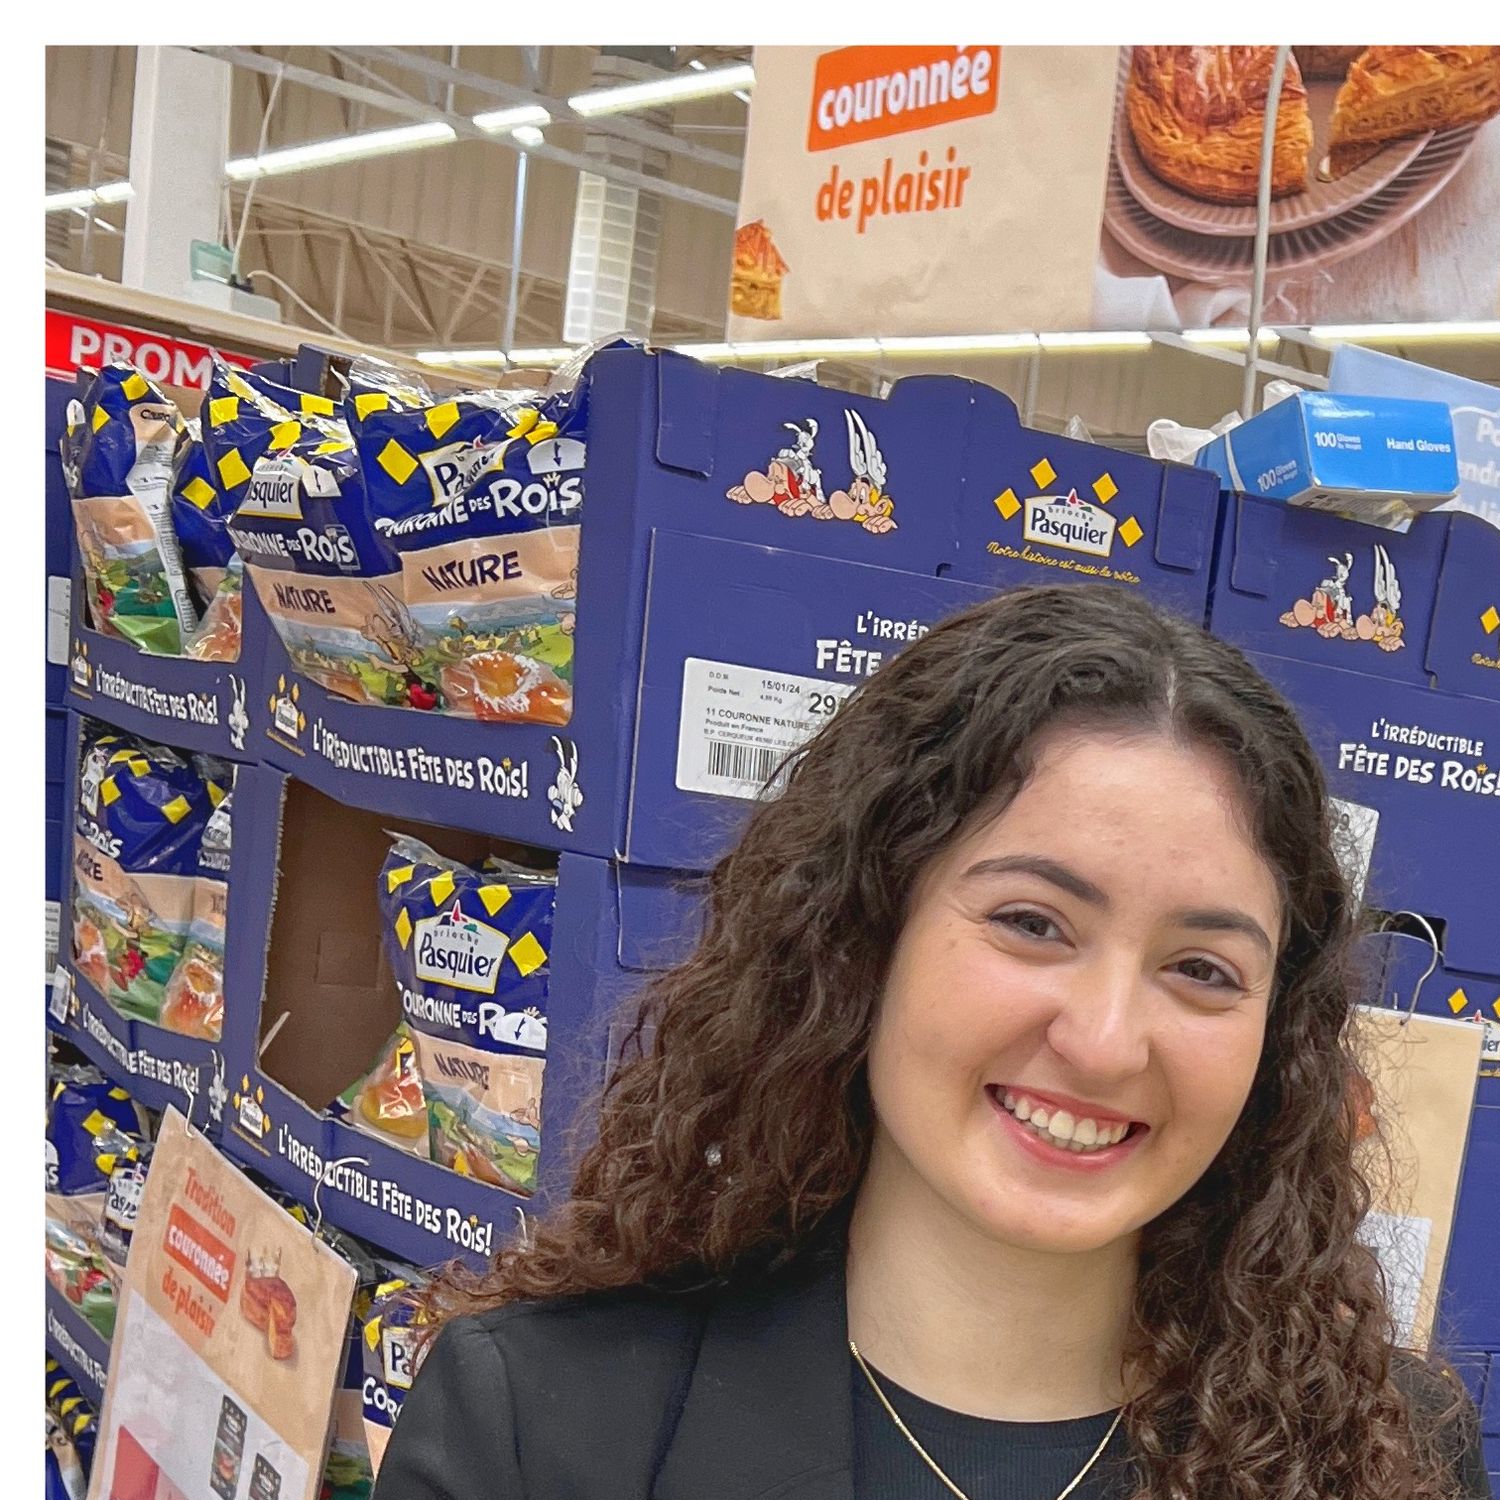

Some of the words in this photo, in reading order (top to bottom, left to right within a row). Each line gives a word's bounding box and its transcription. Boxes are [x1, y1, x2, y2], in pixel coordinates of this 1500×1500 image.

[816, 46, 991, 132] couronnée
[815, 164, 855, 223] de
[857, 147, 972, 235] plaisir
[70, 326, 240, 391] PROM
[1314, 431, 1336, 449] 100
[1386, 438, 1414, 452] Hand
[1416, 439, 1451, 453] Gloves
[1256, 469, 1277, 492] 100
[469, 496, 492, 512] DES
[1031, 507, 1108, 545] Pasquier
[422, 552, 522, 592] NATURE
[274, 582, 336, 613] NATURE
[816, 639, 881, 677] FÊTE
[761, 680, 800, 694] 15/01/24
[705, 719, 729, 728] Produit
[741, 723, 764, 733] France
[706, 707, 716, 716] 11
[718, 709, 771, 726] COURONNE
[773, 717, 811, 731] NATURE
[407, 748, 443, 786] FÊTE
[445, 761, 475, 790] DES
[1338, 743, 1390, 777] FÊTE
[1394, 757, 1435, 784] DES
[419, 932, 497, 979] Pasquier
[397, 981, 461, 1029] OURONNE
[462, 1011, 477, 1025] DES
[185, 1167, 236, 1238] Tradition
[381, 1180, 412, 1221] FÊTE
[415, 1197, 442, 1234] DES
[168, 1225, 229, 1290] couronnée
[162, 1267, 178, 1295] de
[175, 1285, 216, 1338] plaisir
